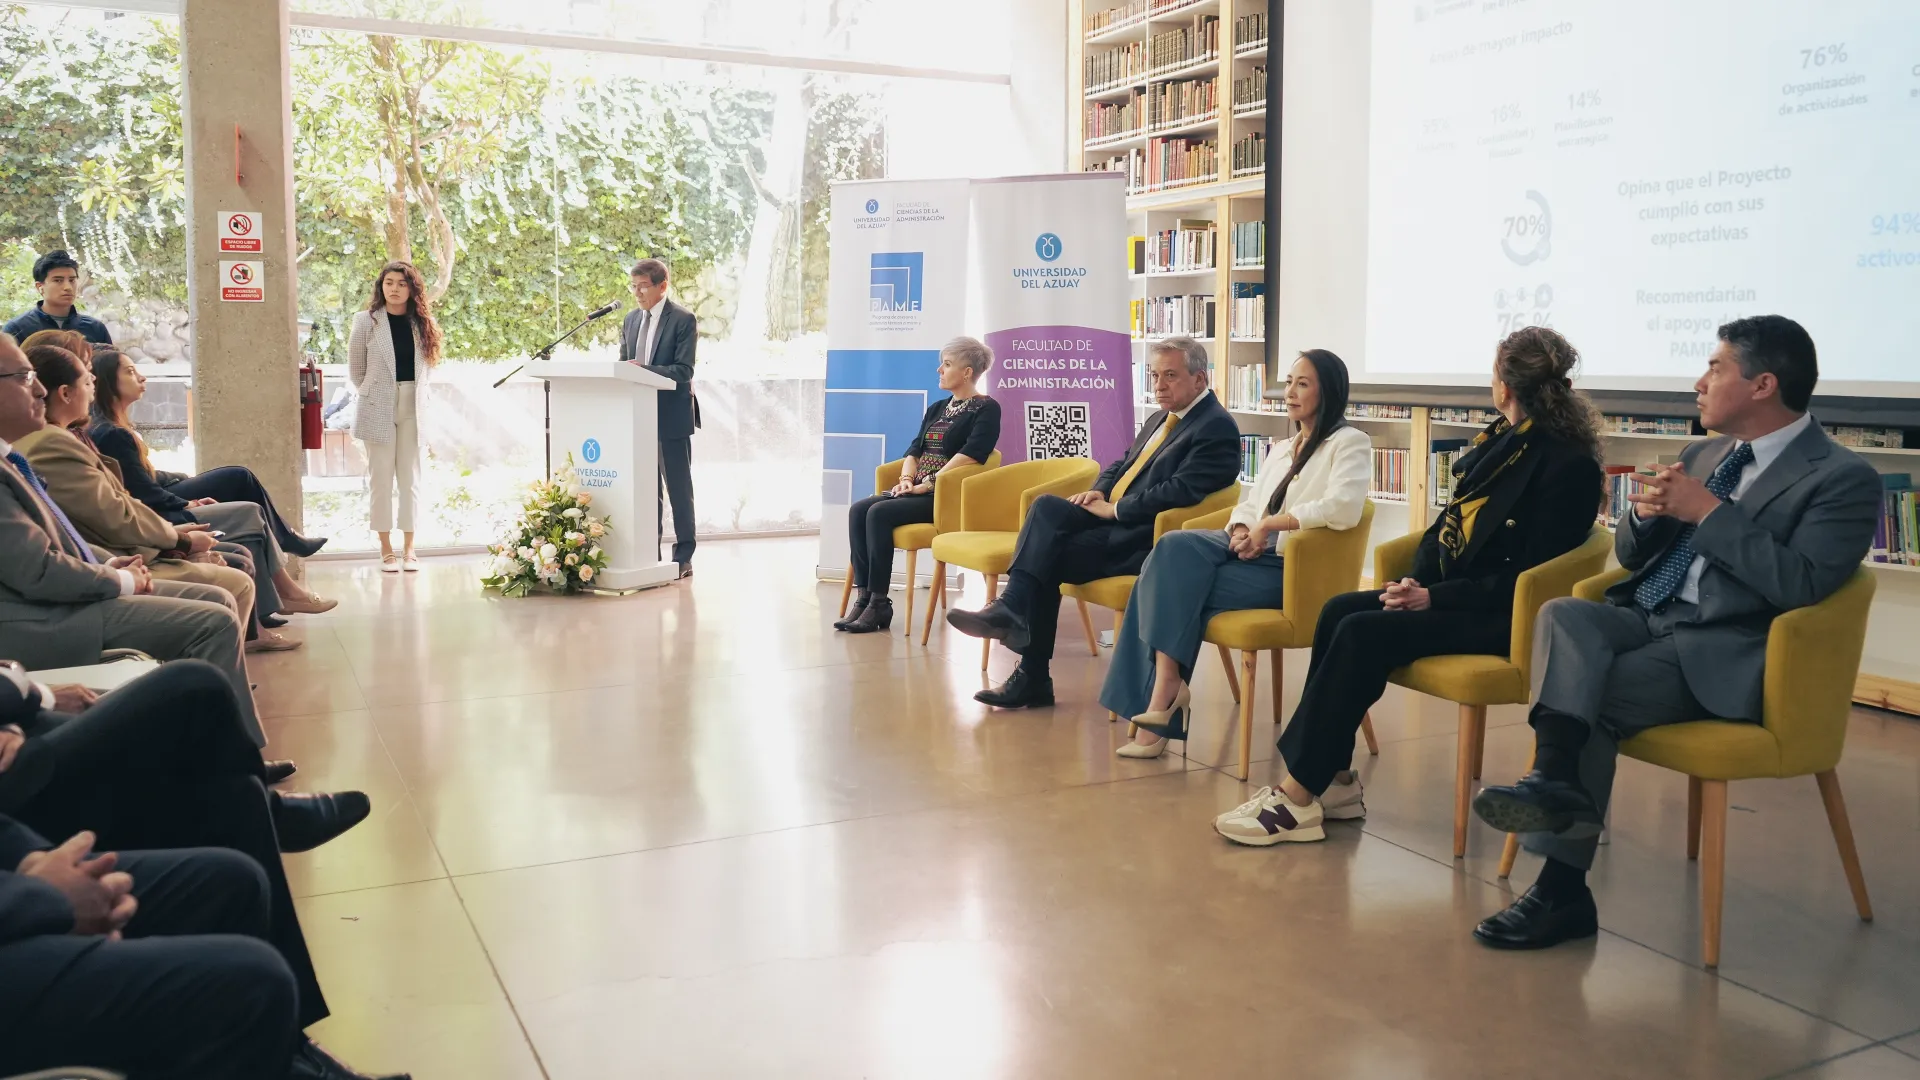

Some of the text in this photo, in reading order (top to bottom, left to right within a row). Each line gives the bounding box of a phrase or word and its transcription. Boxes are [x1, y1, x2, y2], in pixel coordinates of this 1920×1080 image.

[1520, 19, 1574, 45] impacto
[1799, 42, 1849, 70] 76%
[1782, 71, 1866, 97] Organización
[1567, 88, 1603, 111] 14%
[1778, 92, 1869, 117] de actividades
[1617, 162, 1792, 202] Opina que el Proyecto
[1638, 195, 1765, 223] cumplió con sus
[1503, 214, 1546, 238] 70%
[1870, 212, 1920, 236] 94%
[1650, 225, 1750, 249] expectativas
[1013, 267, 1087, 279] UNIVERSIDAD
[1021, 278, 1080, 289] DEL AZUAY
[872, 300, 920, 312] PAME
[1636, 285, 1757, 306] Recomendarían
[1647, 314, 1660, 331] el
[1664, 316, 1713, 335] apoyo
[1012, 339, 1094, 351] FACULTAD DE
[1003, 358, 1108, 371] CIENCIAS DE LA
[997, 375, 1115, 390] ADMINISTRACIÓN
[575, 468, 618, 479] IVERSIDAD
[586, 479, 613, 488] AZUAY
